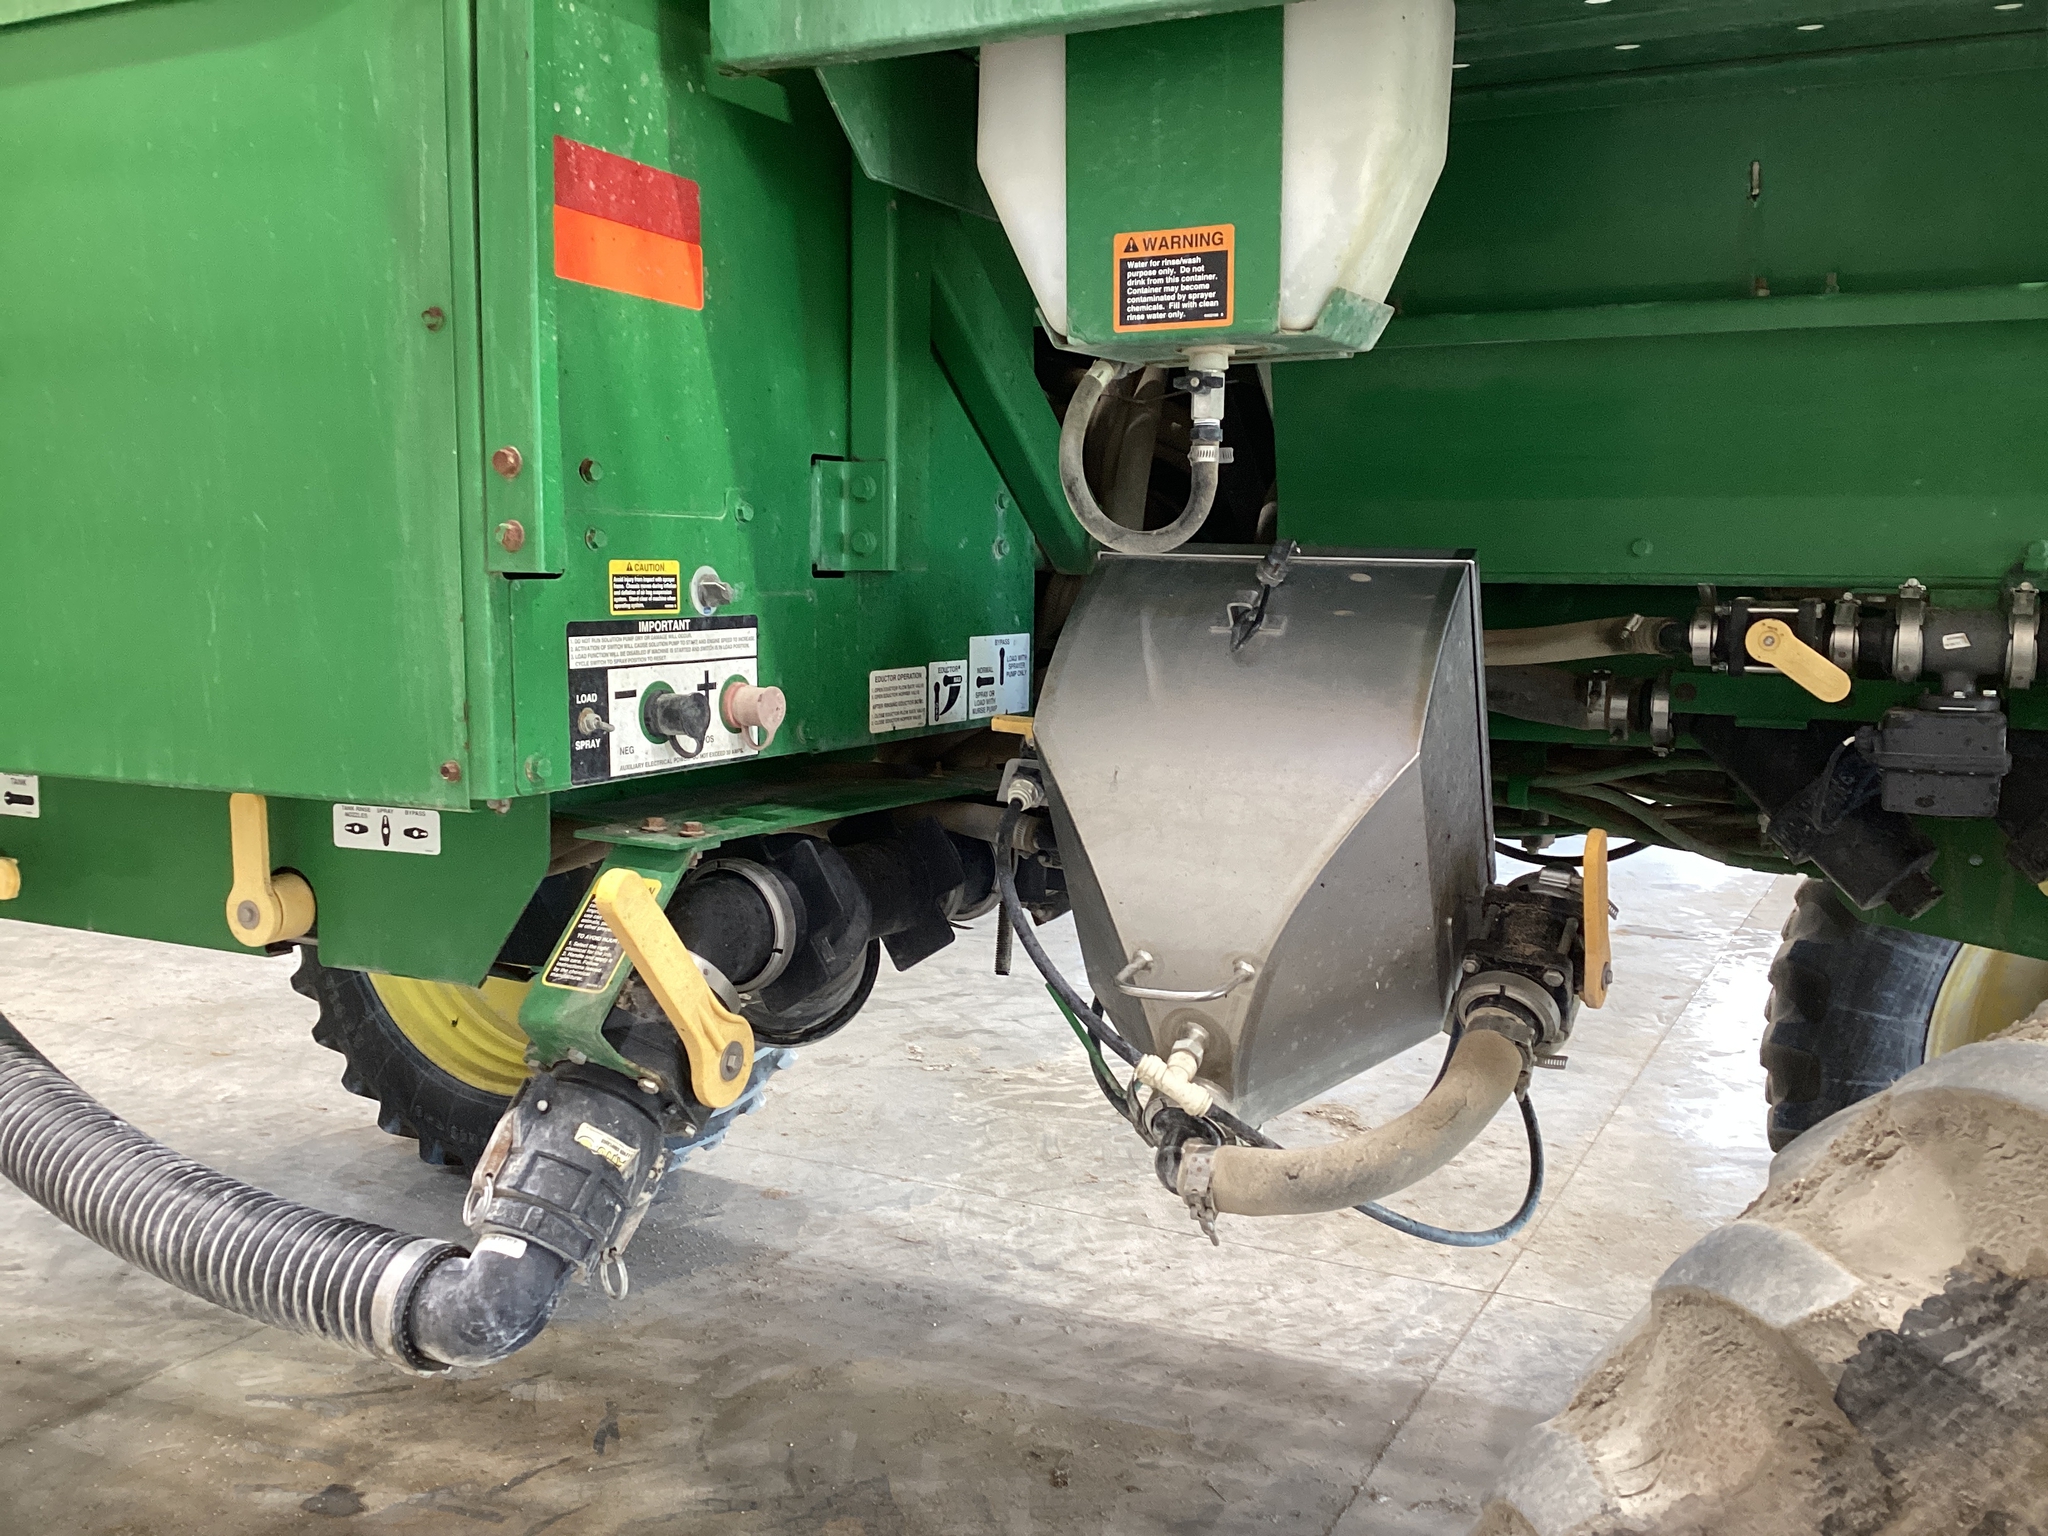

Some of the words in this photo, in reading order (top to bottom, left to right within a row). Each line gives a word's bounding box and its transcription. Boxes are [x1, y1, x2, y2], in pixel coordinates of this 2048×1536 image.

[1143, 232, 1224, 251] WARNING
[1150, 259, 1160, 267] for
[1162, 256, 1201, 266] rinse/wash
[1127, 270, 1156, 279] purpose
[1158, 268, 1176, 277] only.
[1127, 278, 1145, 286] drink
[1147, 276, 1164, 285] from
[1166, 275, 1179, 283] this
[1181, 274, 1217, 282] container.
[1127, 286, 1162, 295] Container
[1181, 283, 1210, 291] become
[1127, 293, 1175, 303] contaminated
[1177, 292, 1186, 301] by
[1188, 292, 1216, 301] sprayer
[1127, 303, 1165, 312] chemicals.
[1169, 301, 1180, 309] Fill
[1182, 300, 1197, 308] with
[1147, 312, 1166, 320] water
[1168, 310, 1185, 320] only.
[634, 563, 664, 571] CAUTION
[638, 620, 690, 632] IMPORTANT
[875, 675, 896, 683] EDUCTOR
[897, 672, 922, 680] OPERATION
[576, 693, 597, 704] LOAD
[575, 738, 600, 750] SPRAY
[706, 735, 714, 743] OS
[620, 746, 634, 755] NEG
[620, 762, 644, 771] AUXILIARY
[645, 759, 672, 767] ELECTRICAL
